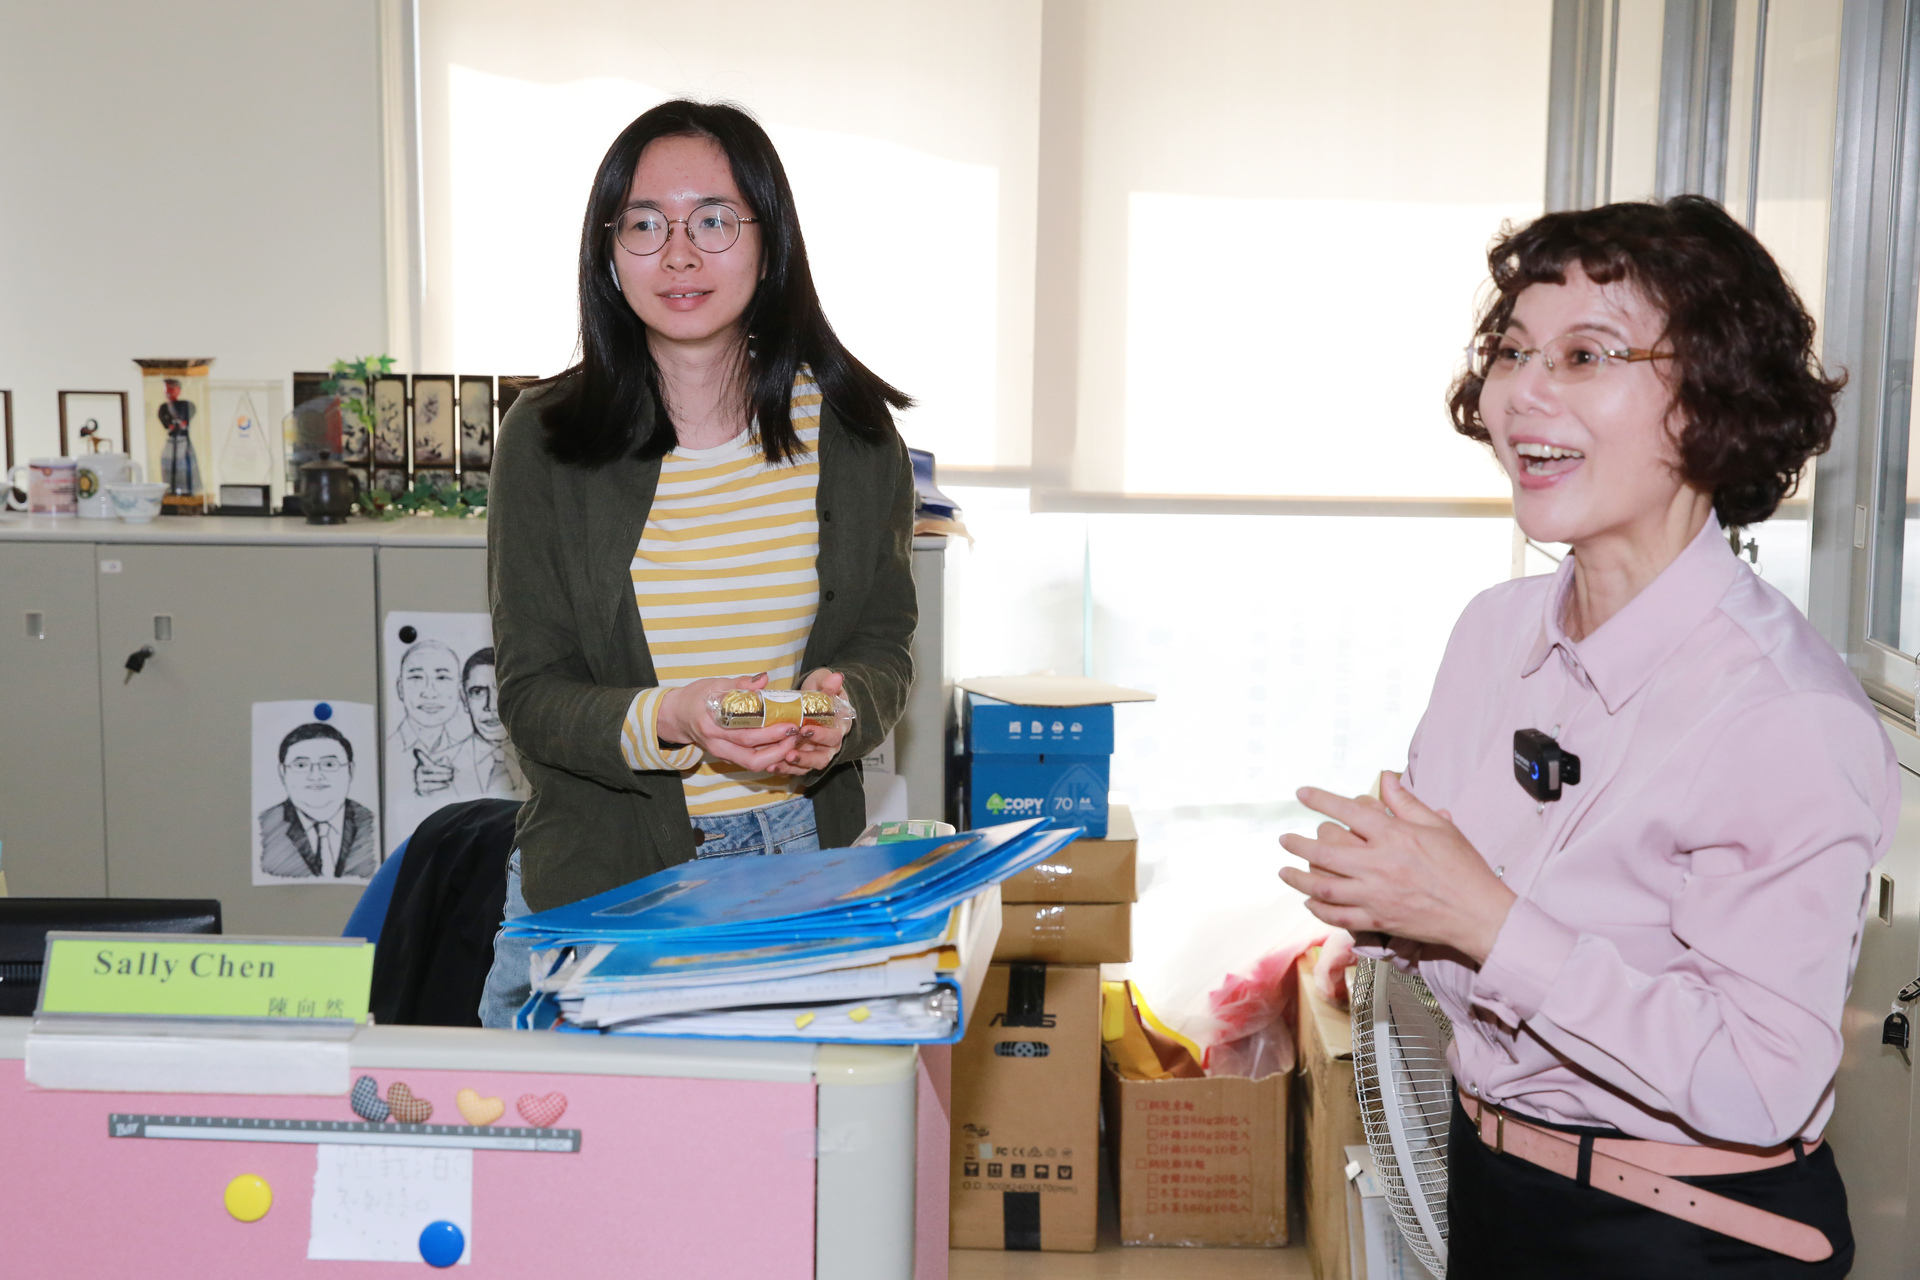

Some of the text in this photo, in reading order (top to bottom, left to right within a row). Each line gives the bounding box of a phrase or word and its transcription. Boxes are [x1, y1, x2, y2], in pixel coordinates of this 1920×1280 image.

[1004, 797, 1044, 810] COPY
[1054, 797, 1074, 811] 70
[93, 949, 276, 983] Sally Chen
[989, 1012, 1057, 1028] AS
